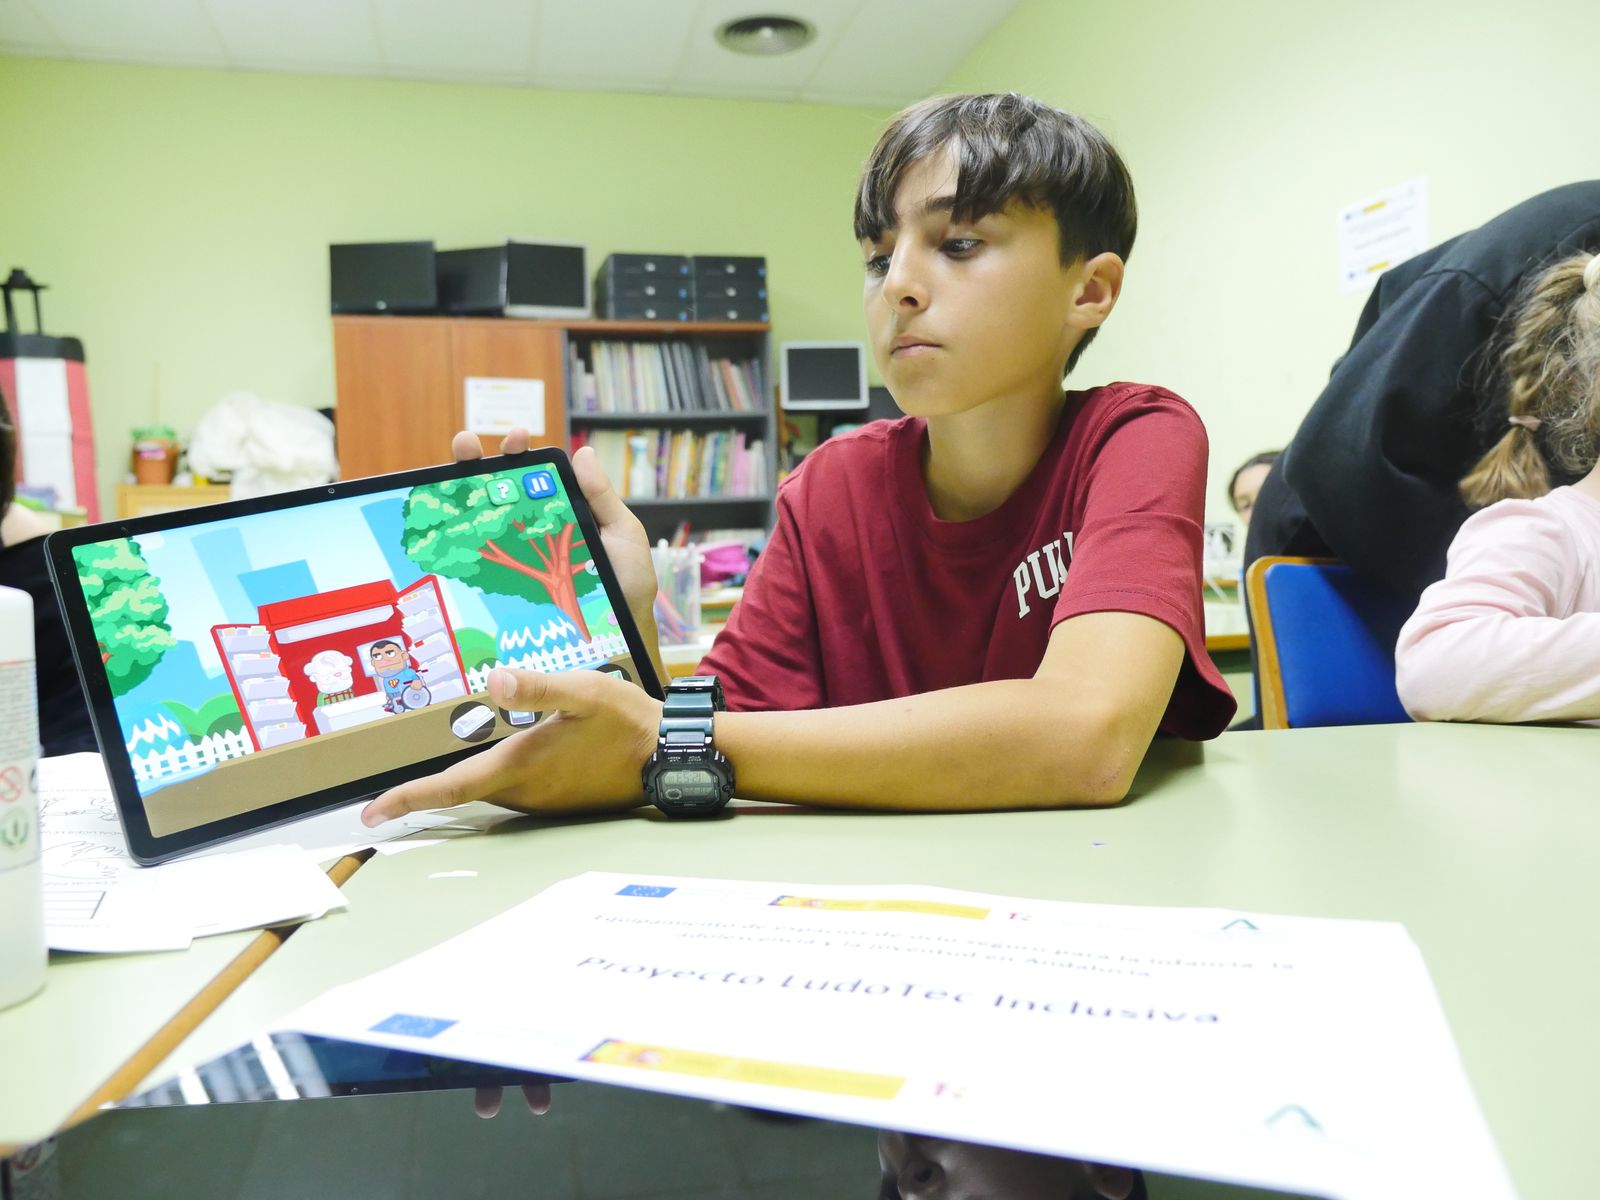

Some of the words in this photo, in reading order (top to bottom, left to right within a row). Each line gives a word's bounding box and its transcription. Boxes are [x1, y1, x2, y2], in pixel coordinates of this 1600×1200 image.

[1012, 531, 1073, 619] PU
[576, 955, 766, 985] Proyecto
[780, 974, 973, 1004] LudoTec
[993, 993, 1222, 1026] Inclusiva
